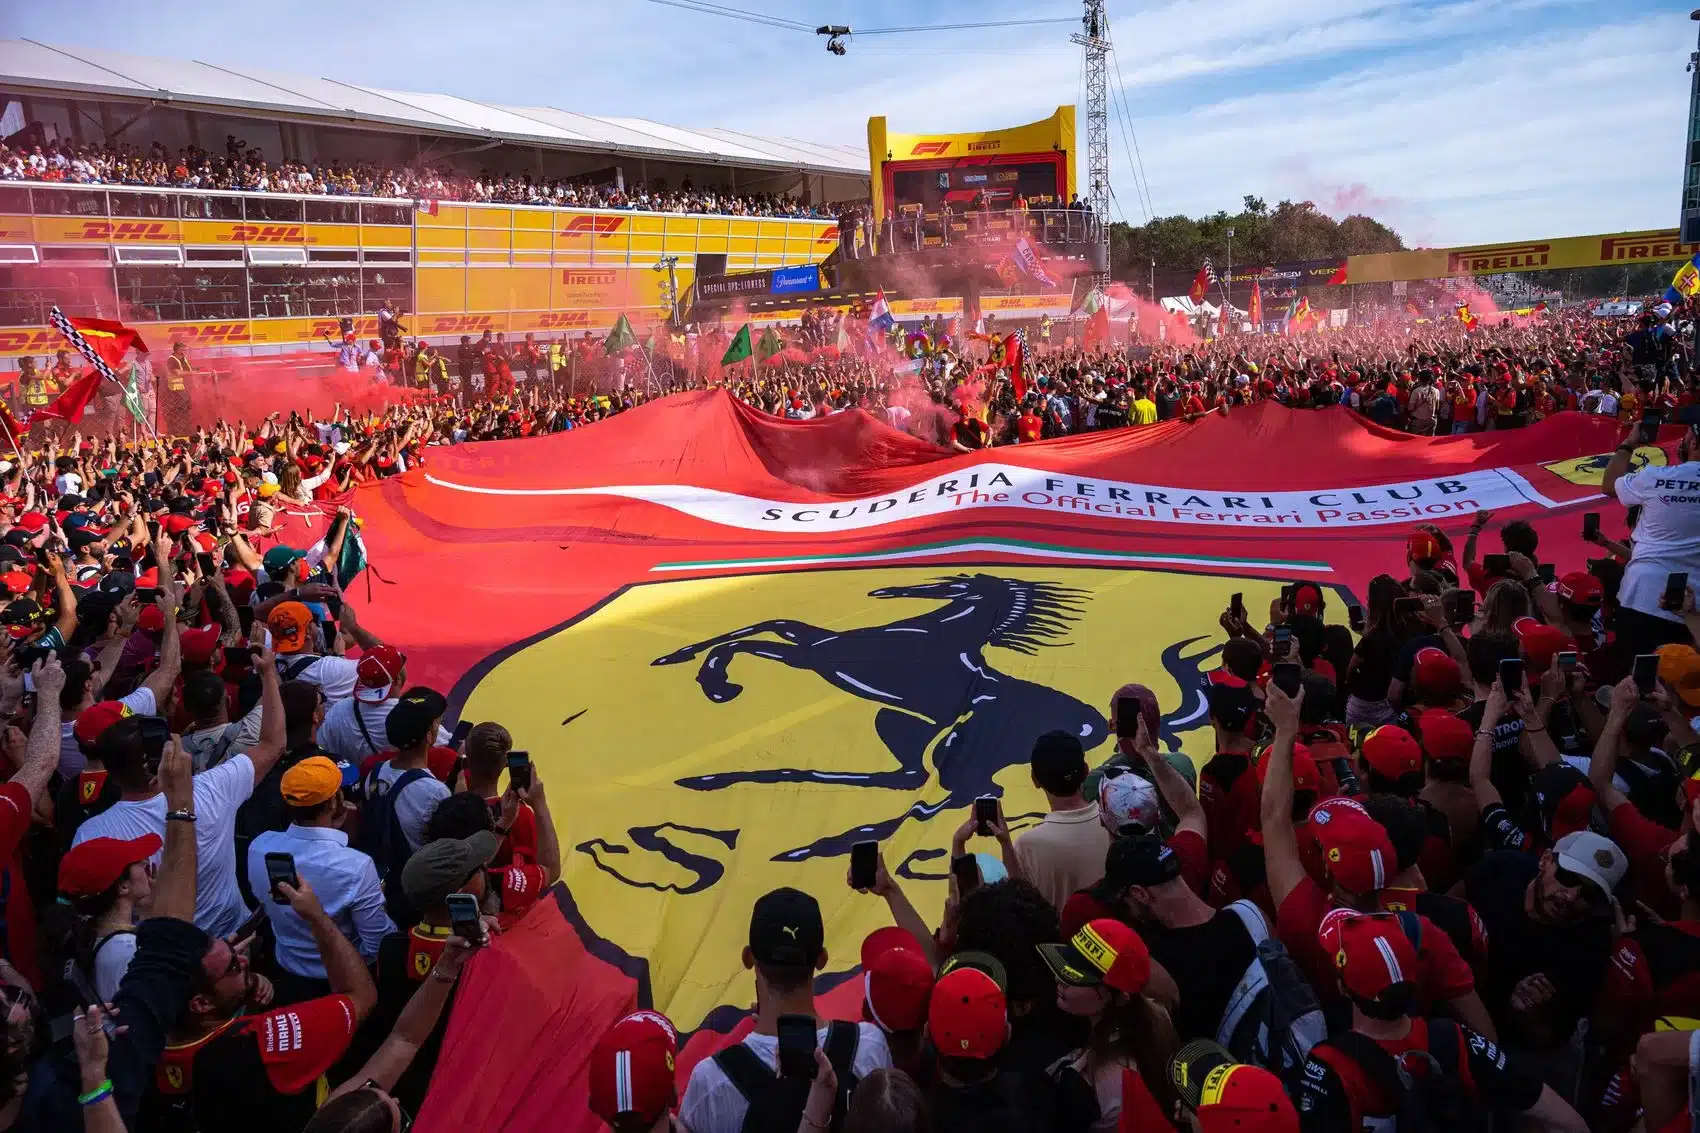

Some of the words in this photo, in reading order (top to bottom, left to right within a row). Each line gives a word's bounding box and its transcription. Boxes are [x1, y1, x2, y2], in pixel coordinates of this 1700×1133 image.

[81, 222, 170, 240] DHL
[231, 225, 306, 242] DHL
[1600, 231, 1700, 261] PIREL
[1447, 244, 1550, 273] PIRELLI
[563, 269, 617, 285] PIRELLI
[703, 283, 726, 294] SPECIAL
[433, 316, 494, 332] DHL
[538, 312, 592, 328] DHL
[0, 332, 75, 351] DH
[168, 325, 251, 342] DHL
[761, 472, 1013, 522] SCUDERIA
[1046, 478, 1274, 509] FERRARI
[1309, 479, 1468, 507] CLUB
[1663, 495, 1700, 504] CROW
[946, 490, 1010, 506] The
[1021, 491, 1156, 518] Official
[1172, 508, 1303, 524] Ferrari
[1316, 499, 1480, 523] Passion
